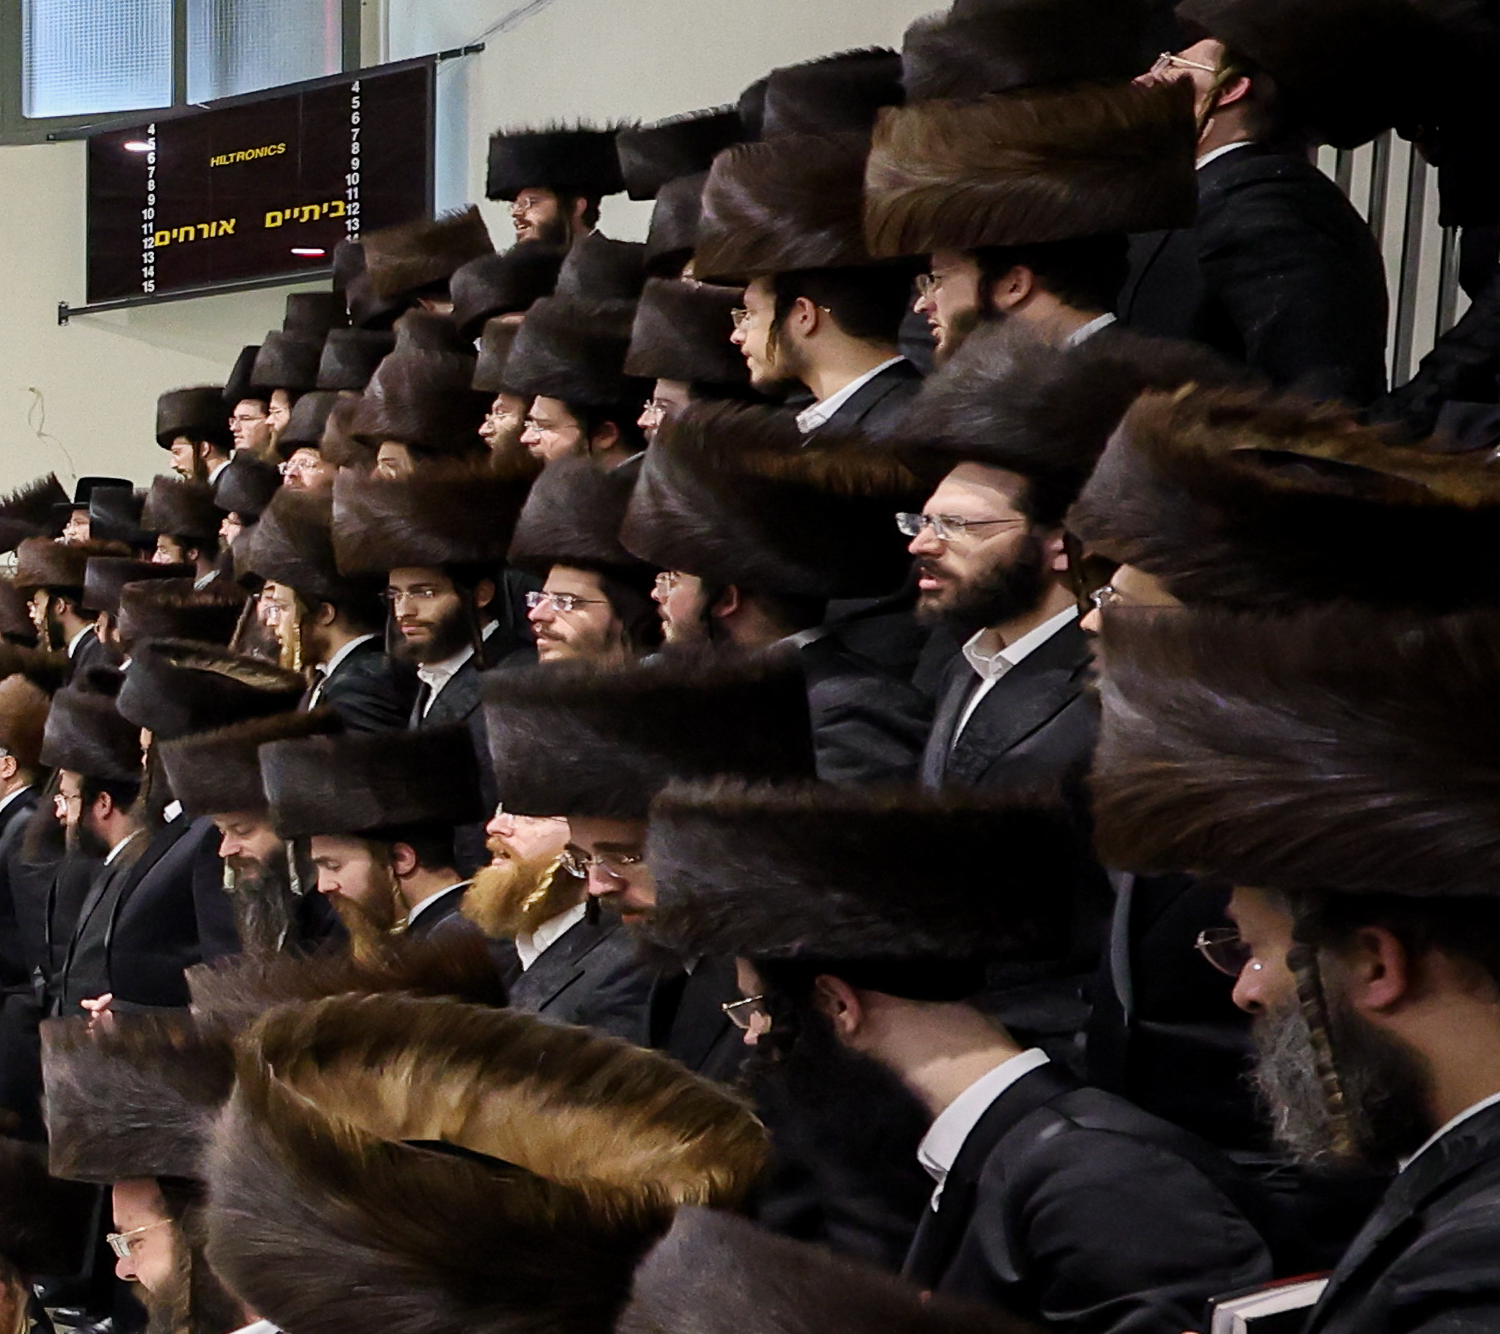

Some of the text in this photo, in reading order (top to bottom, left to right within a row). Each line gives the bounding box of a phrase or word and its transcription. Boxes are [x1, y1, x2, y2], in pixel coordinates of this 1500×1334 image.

[351, 80, 360, 93] 4
[351, 95, 360, 109] 5
[351, 111, 361, 125] 6
[147, 123, 156, 135] 4
[351, 128, 360, 141] 7
[210, 142, 286, 167] HILTRONICS
[351, 142, 360, 155] 8
[147, 152, 156, 165] 6
[351, 157, 360, 171] 9
[147, 166, 156, 179] 7
[345, 172, 360, 186] 10
[147, 179, 156, 191] 8
[147, 194, 156, 206] 9
[345, 186, 359, 201] 11
[141, 207, 155, 220] 10
[264, 200, 346, 228] ביתיים
[345, 202, 360, 216] 12
[141, 222, 154, 235] 11
[344, 217, 360, 232] 13
[154, 218, 237, 247] אורחים
[141, 236, 155, 250] 12
[141, 251, 155, 264] 13
[141, 265, 155, 278] 14
[141, 280, 155, 293] 15
